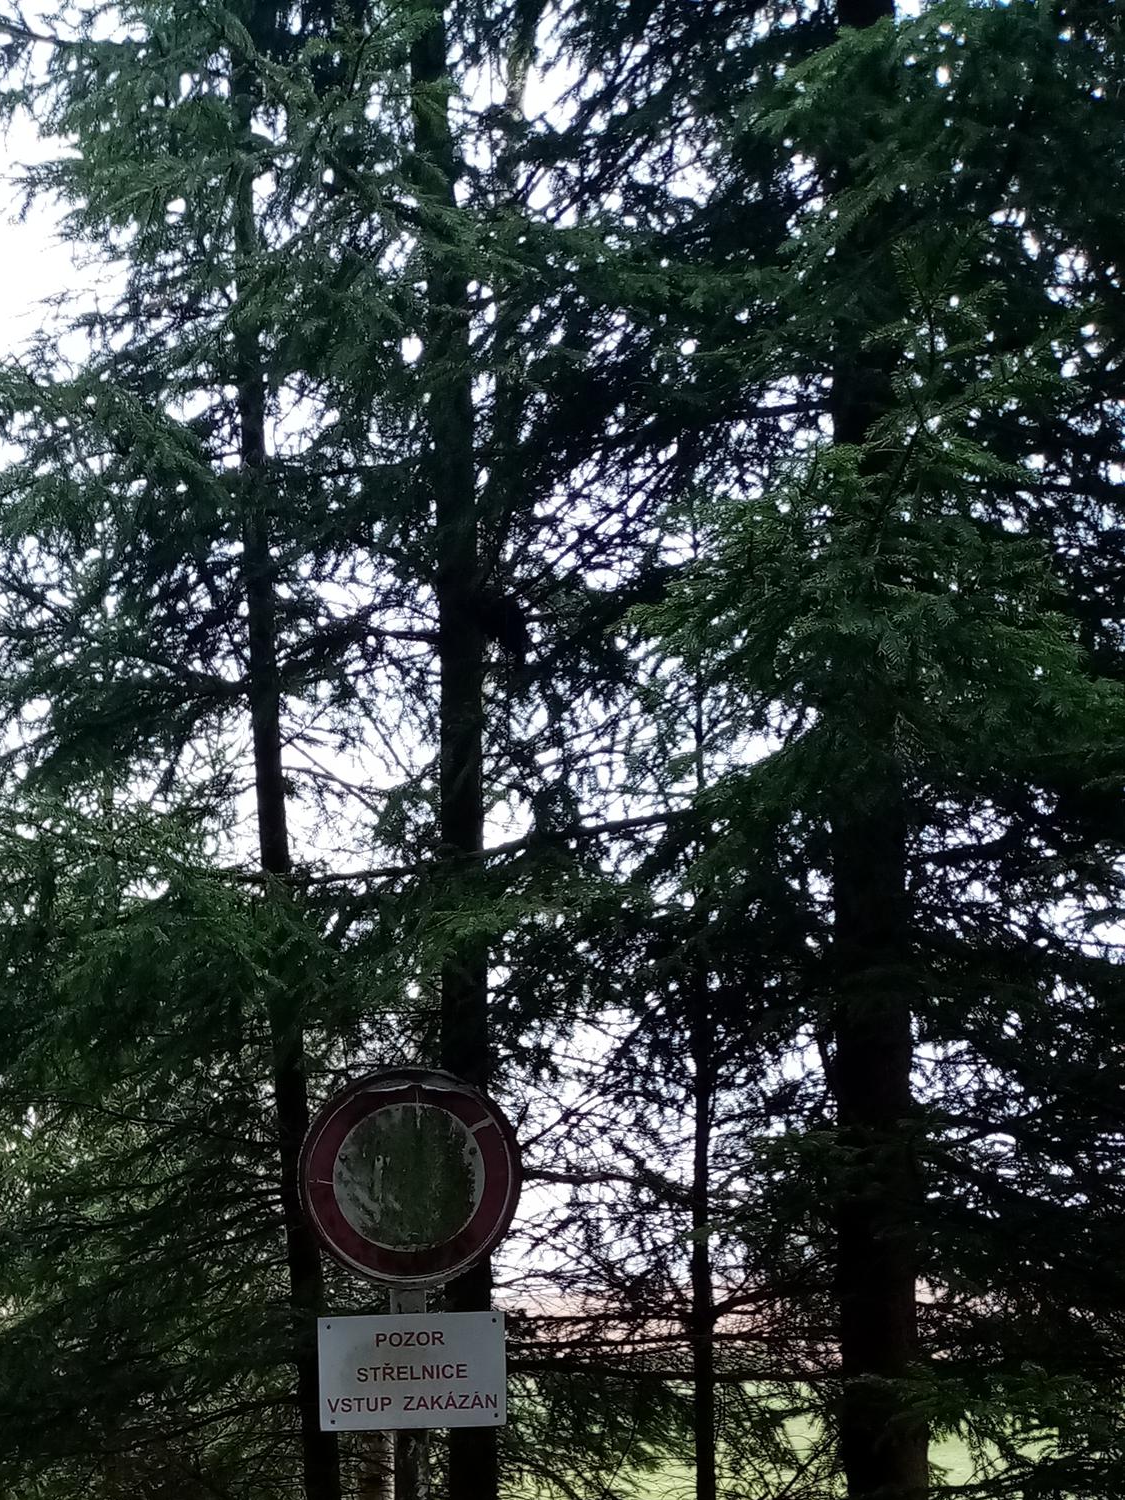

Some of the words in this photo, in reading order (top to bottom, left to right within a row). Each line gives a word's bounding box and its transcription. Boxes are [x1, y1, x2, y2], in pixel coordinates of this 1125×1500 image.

[375, 1331, 445, 1347] POZOR
[356, 1362, 468, 1383] STŘELNICE
[327, 1397, 392, 1413] VSTUP
[403, 1391, 498, 1411] ZAKÁZÁN
